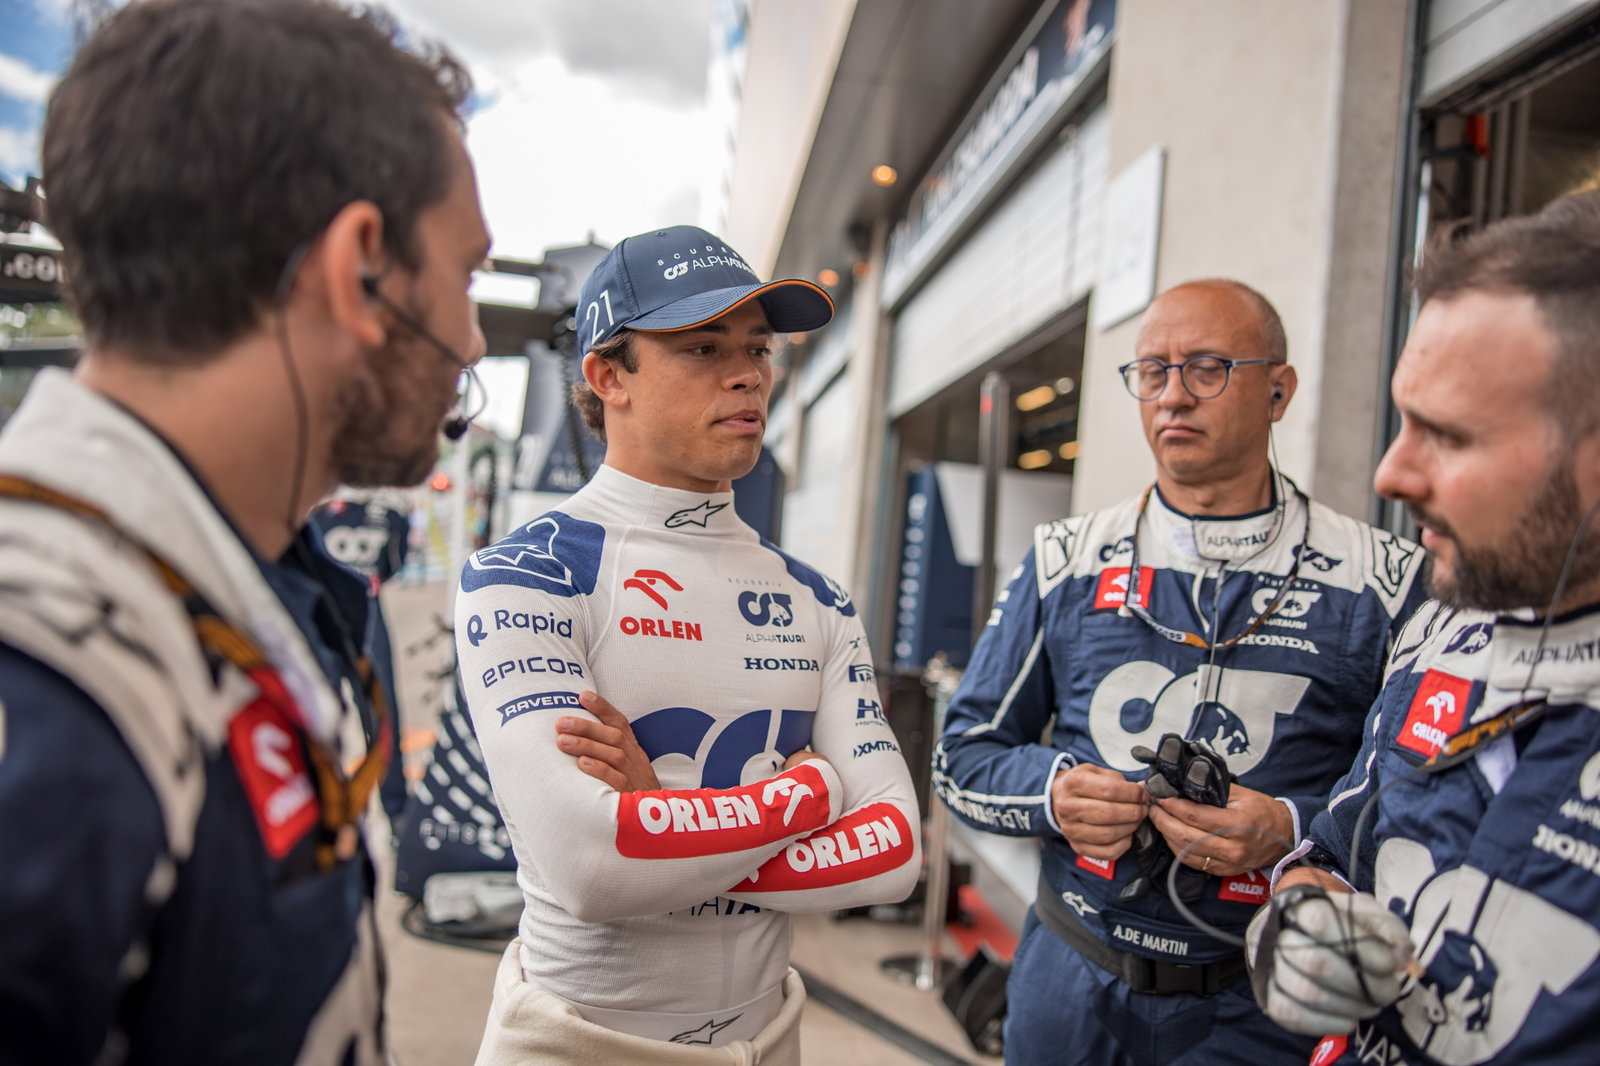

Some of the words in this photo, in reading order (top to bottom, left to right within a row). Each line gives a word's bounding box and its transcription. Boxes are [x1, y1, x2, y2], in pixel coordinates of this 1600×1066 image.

[586, 289, 615, 345] 21
[494, 609, 572, 639] Rapid
[619, 616, 703, 641] ORLEN
[745, 633, 806, 644] ALPHATAURI
[743, 657, 820, 672] HONDA
[638, 794, 760, 835] ORLEN
[786, 816, 902, 873] ORLEN
[1112, 924, 1140, 942] A.DE
[1142, 933, 1189, 956] MARTIN
